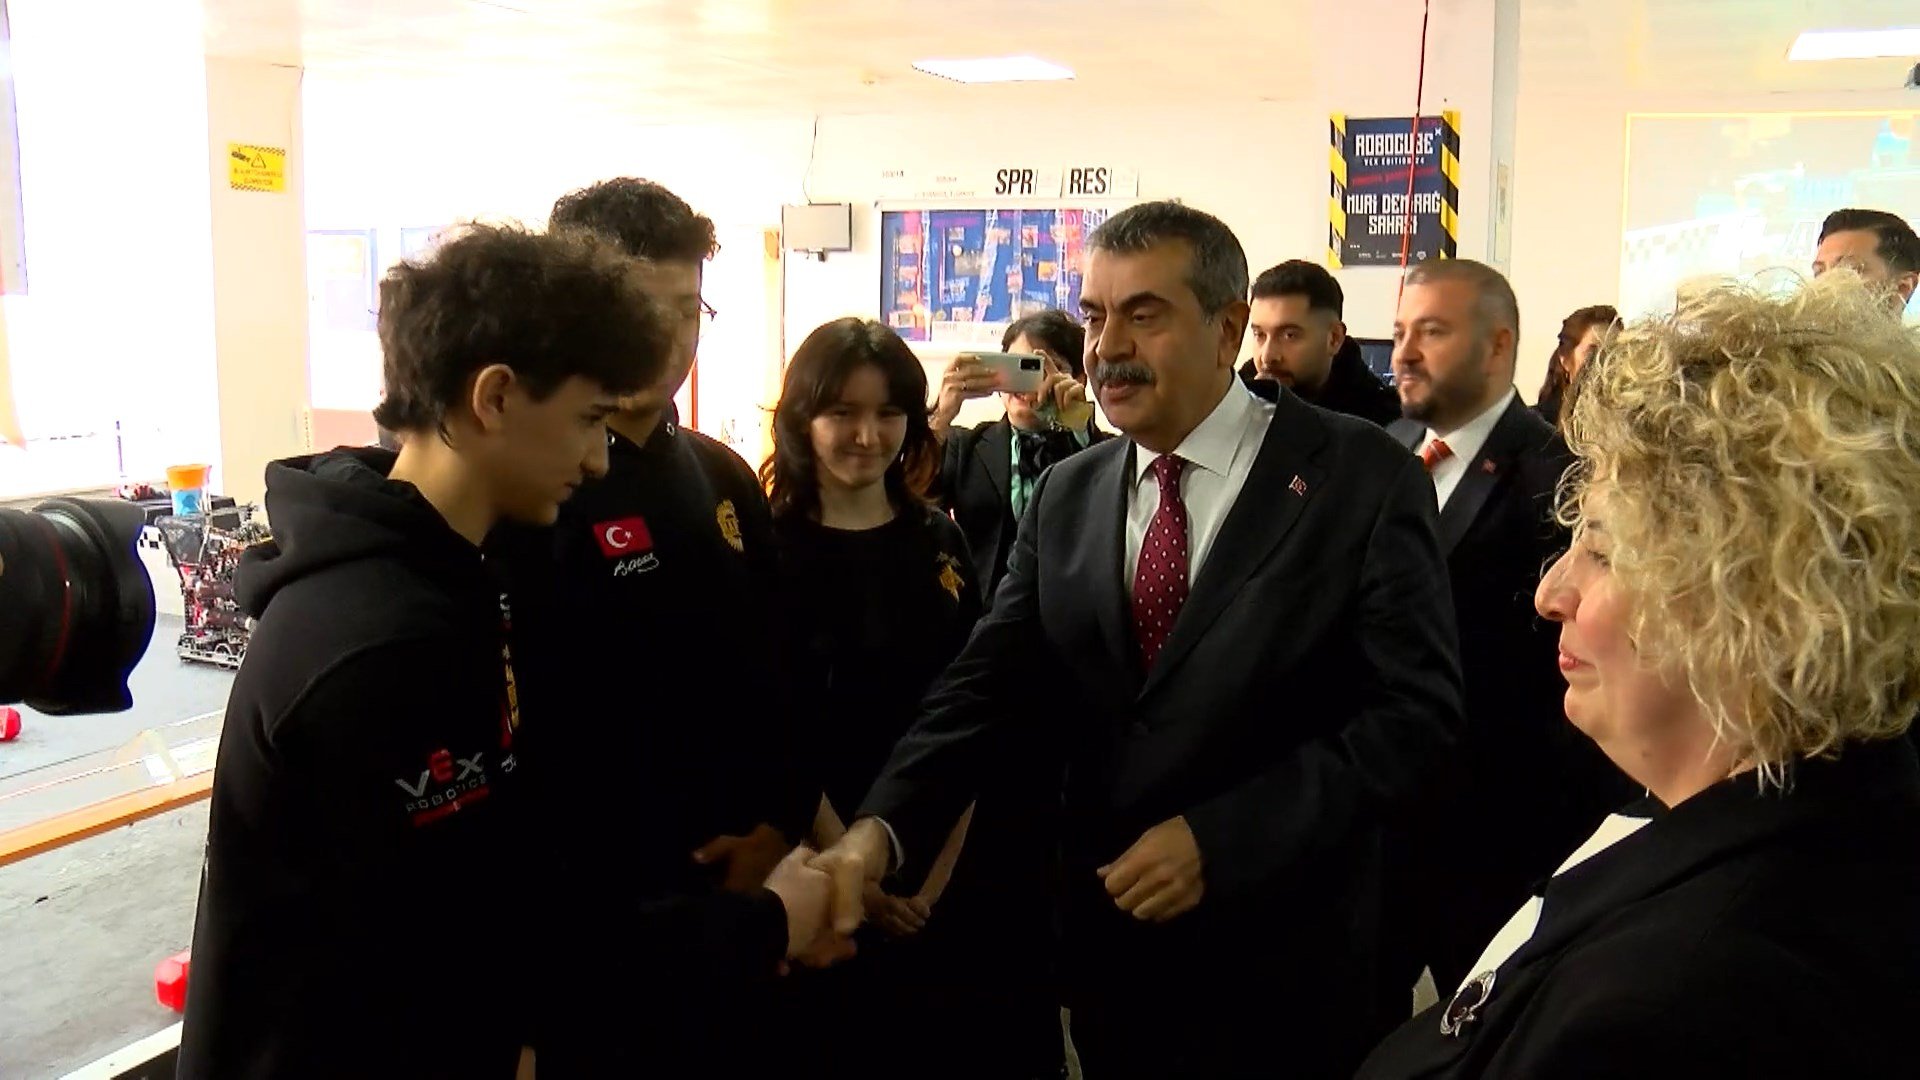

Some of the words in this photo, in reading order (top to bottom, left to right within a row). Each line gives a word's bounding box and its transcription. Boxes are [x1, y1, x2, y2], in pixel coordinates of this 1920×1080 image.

[1355, 133, 1434, 156] ROBOCUBE
[995, 169, 1034, 196] SPR
[1069, 167, 1107, 195] RES
[395, 749, 484, 798] VEX
